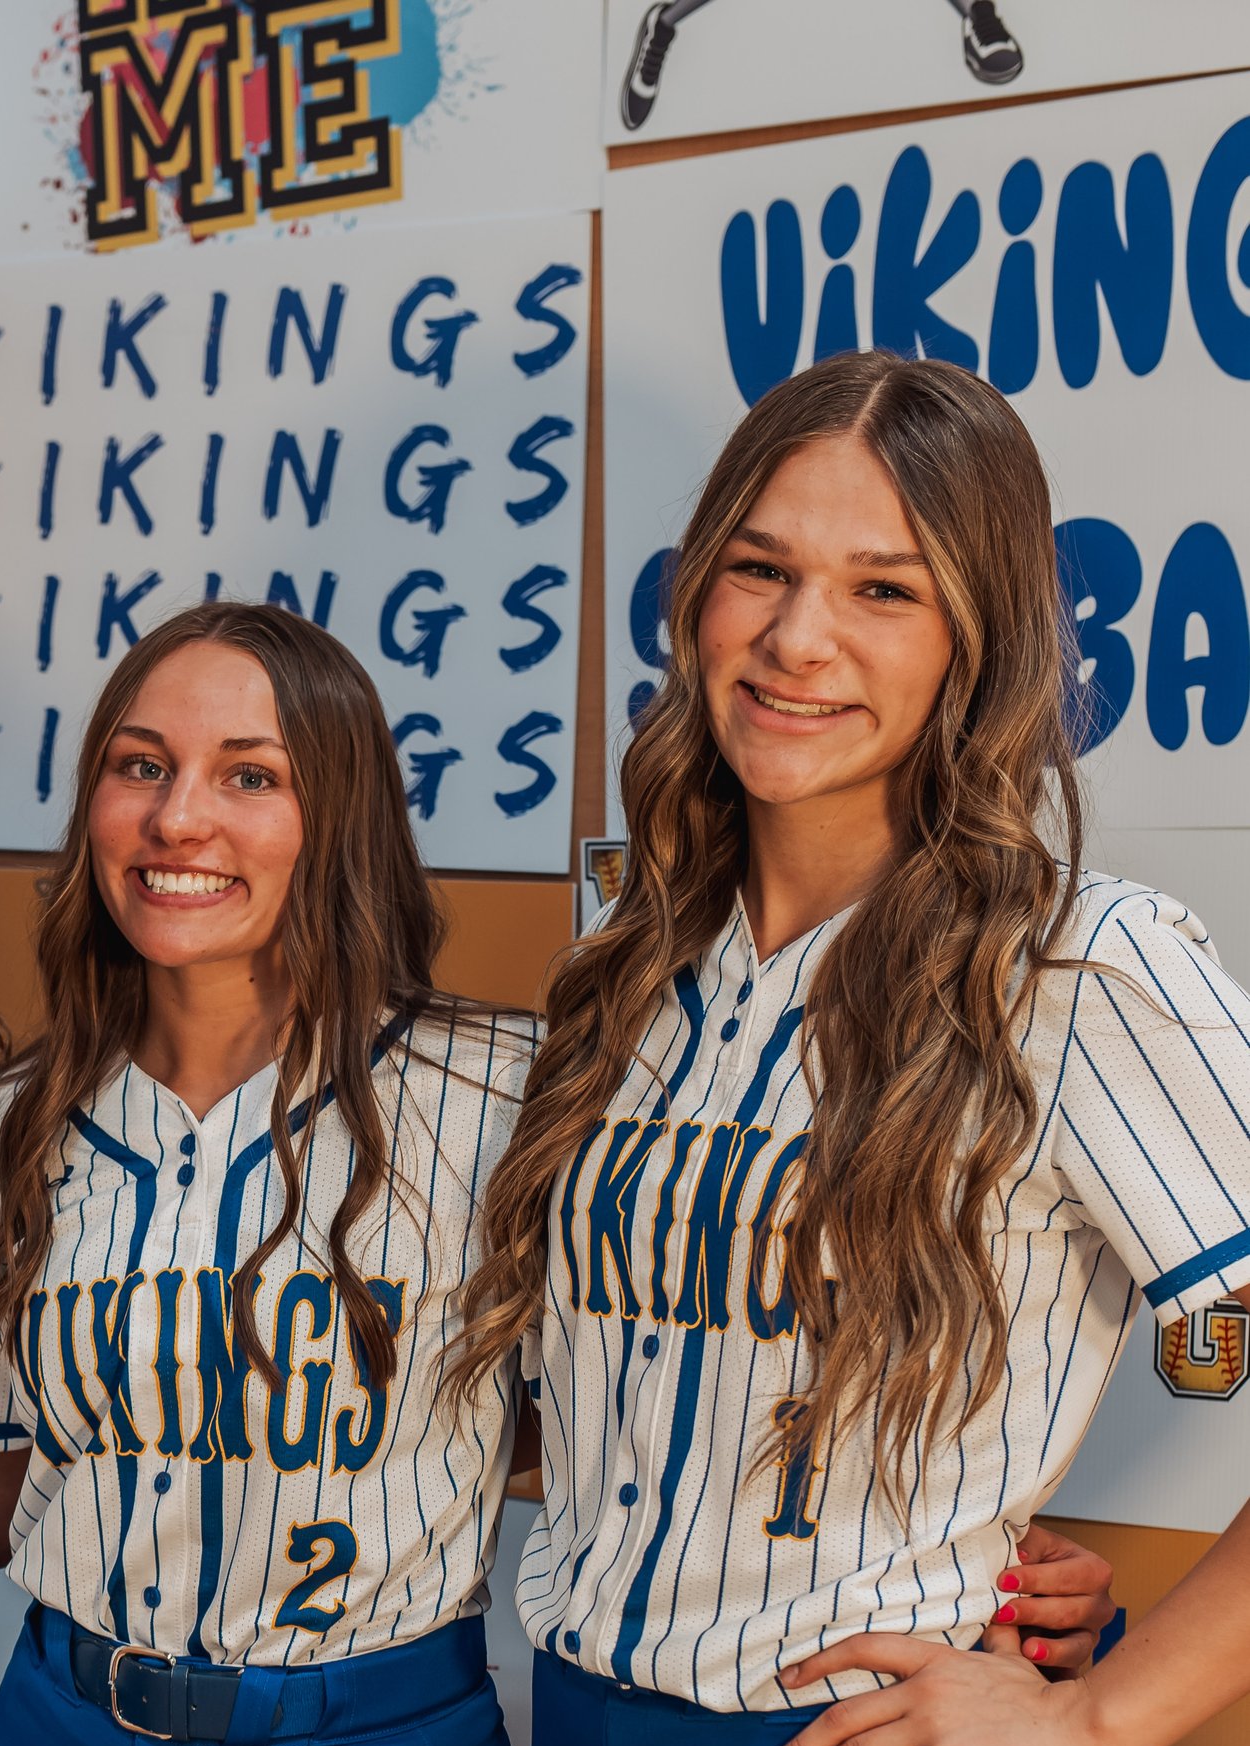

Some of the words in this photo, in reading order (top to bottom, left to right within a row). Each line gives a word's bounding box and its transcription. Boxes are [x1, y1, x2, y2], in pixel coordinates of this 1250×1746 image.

[80, 0, 403, 252] ME
[761, 1398, 825, 1542] 1
[272, 1517, 360, 1636] 2
